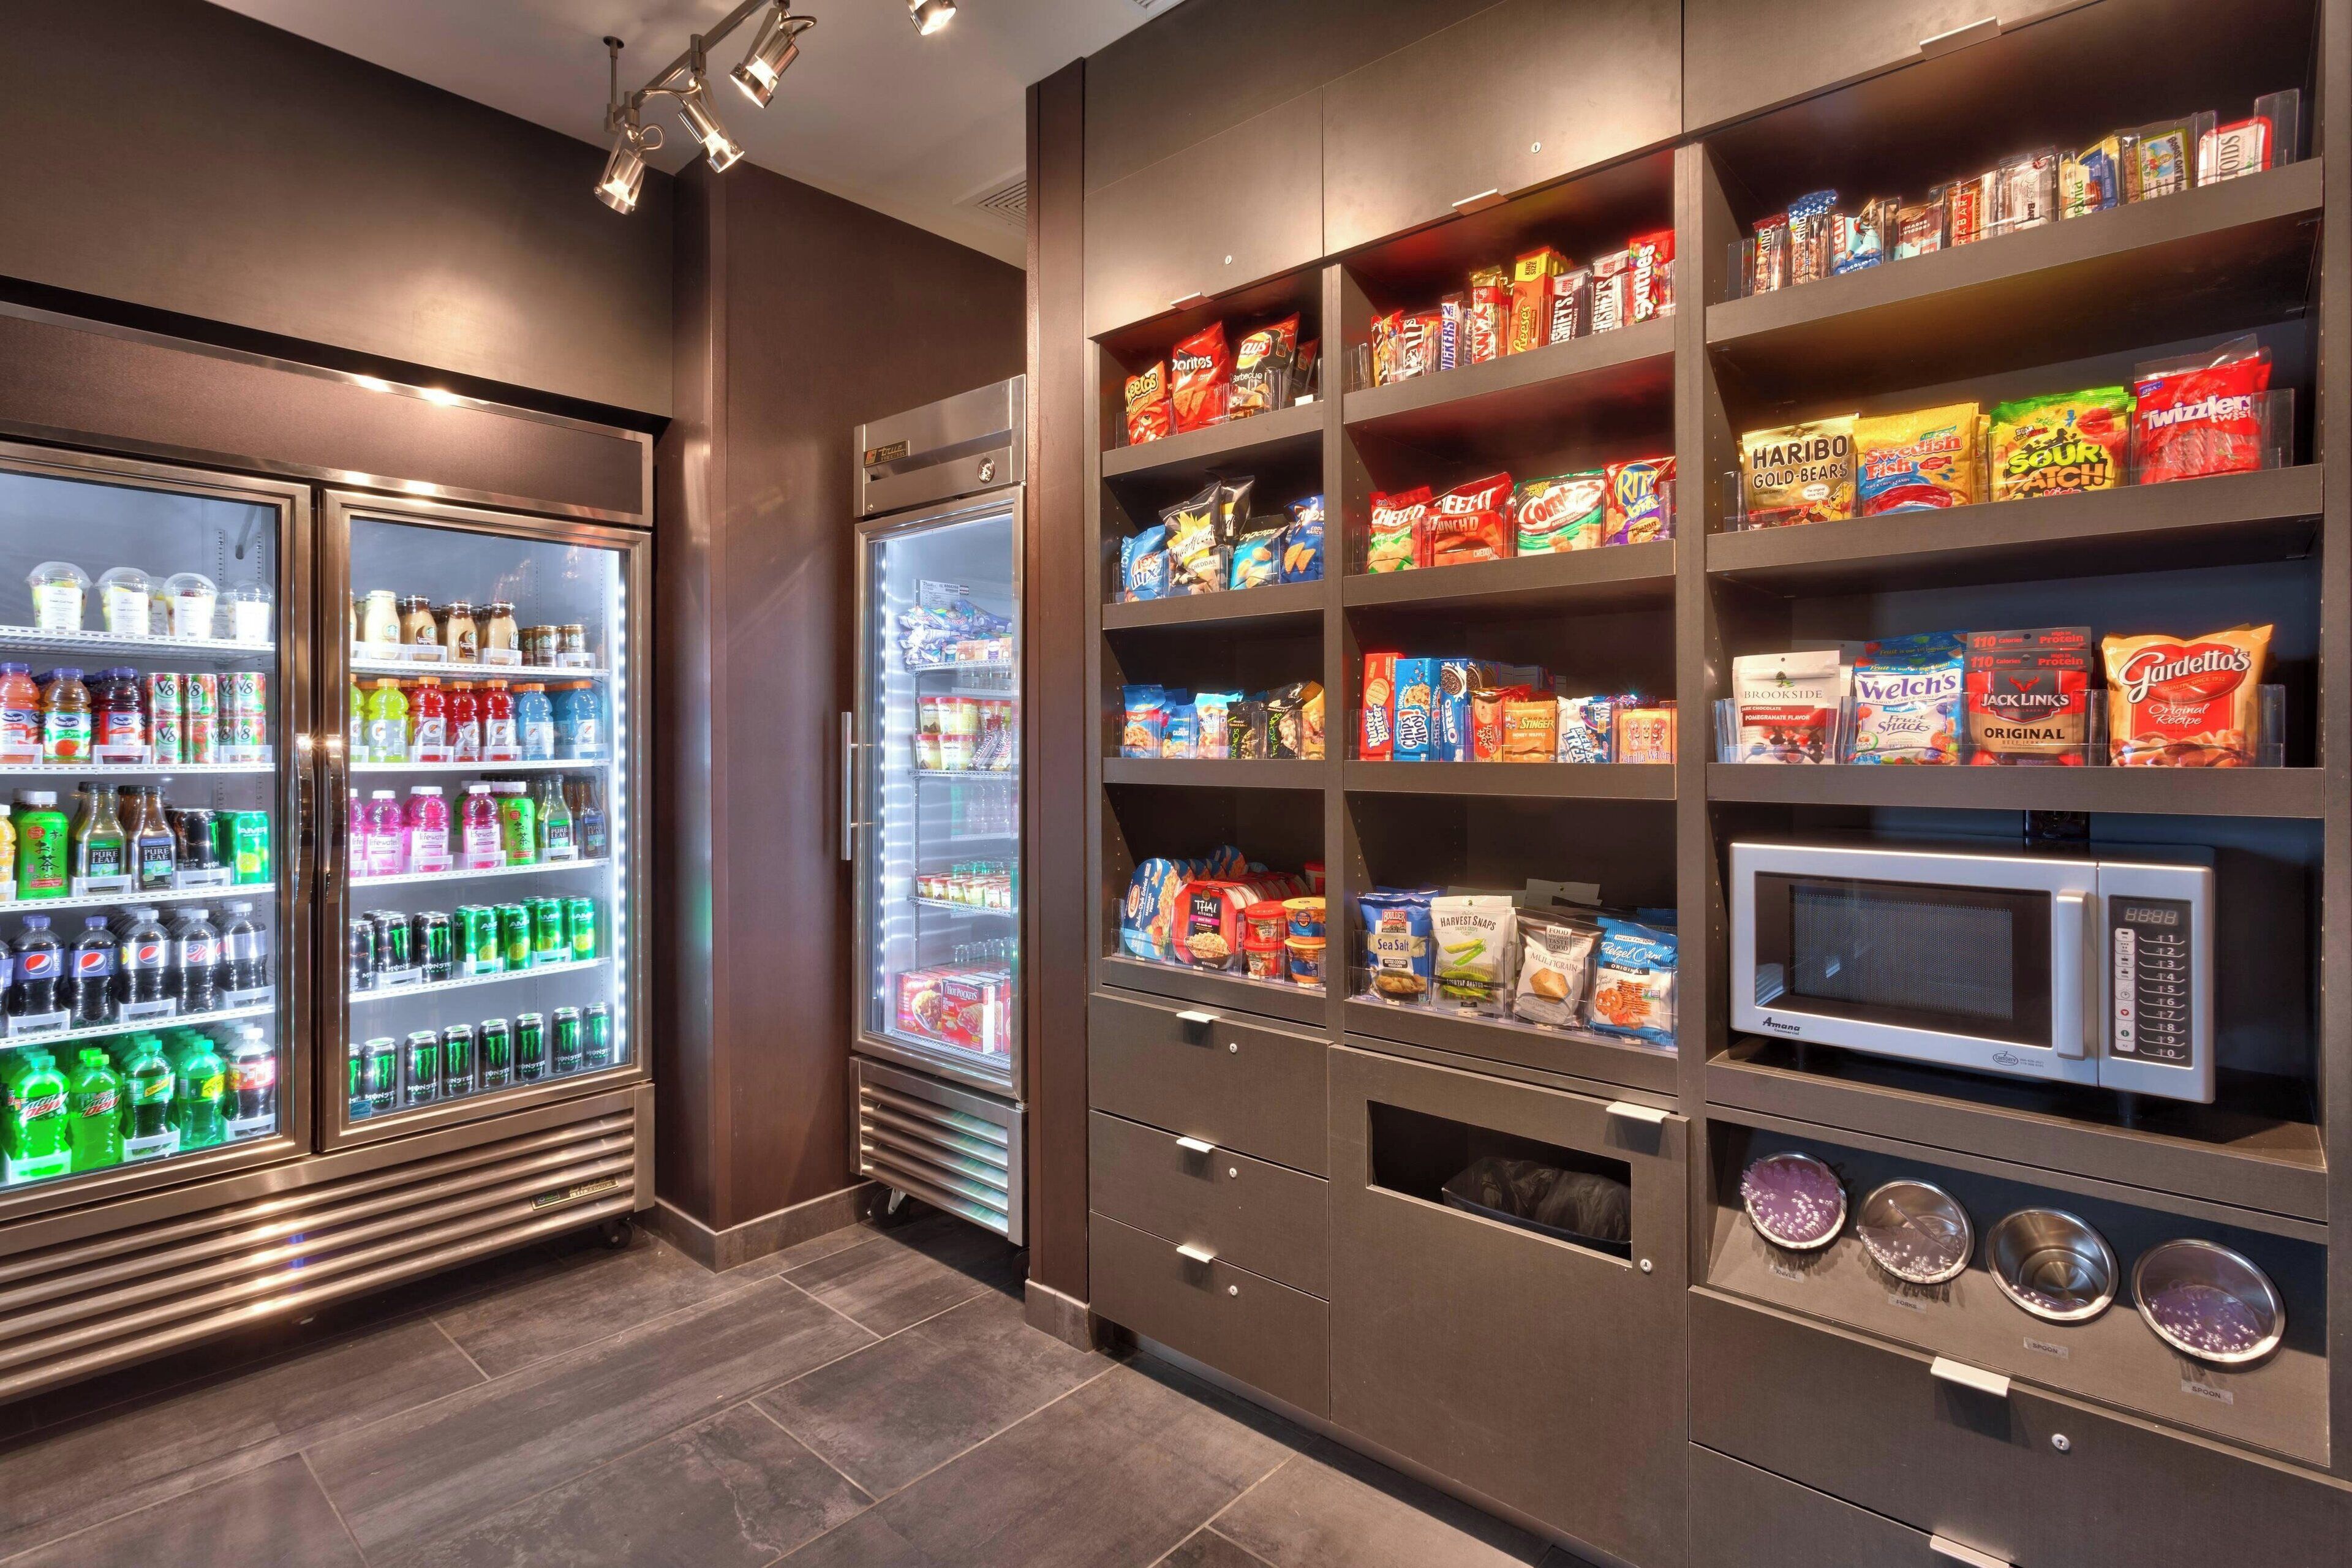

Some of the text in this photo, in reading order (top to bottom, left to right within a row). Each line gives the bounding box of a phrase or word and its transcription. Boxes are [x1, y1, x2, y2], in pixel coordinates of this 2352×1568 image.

[1796, 217, 1806, 244] KIND
[1761, 228, 1772, 254] KIND
[1513, 306, 1531, 352] Reese's
[1753, 435, 1847, 470] HARIBO
[1865, 435, 1962, 464] Swedish
[2009, 442, 2100, 474] SOUR
[1753, 463, 1849, 489] GOLD-BEARS
[1866, 458, 1912, 480] Fish
[2007, 463, 2105, 492] PATCH
[1618, 470, 1658, 504] RITZ
[1191, 559, 1216, 570] CHEDDAR
[1973, 635, 1997, 648] 110
[2038, 634, 2084, 644] Protein
[1970, 656, 1994, 668] 110
[2038, 657, 2084, 666] Protein
[2117, 648, 2252, 704] Gardetto's
[156, 680, 175, 696] V8
[238, 680, 254, 695] V8
[1859, 674, 1956, 700] Welch's
[1744, 690, 1823, 699] BROOKSIDE
[1981, 693, 2070, 707] JACK LINK'S
[2148, 703, 2210, 717] Original
[1372, 704, 1390, 743] Butter
[1444, 699, 1458, 745] OREO
[1519, 718, 1555, 731] STINGER
[1876, 721, 1931, 735] Snacks
[2152, 714, 2203, 728] Recipe
[157, 726, 176, 742] V8
[1365, 709, 1380, 748] Nutter
[1984, 728, 2065, 739] ORIGINAL
[1194, 900, 1217, 913] THAI
[1383, 910, 1406, 922] BOULDER
[1440, 915, 1496, 931] HARVEST SNAPS
[1549, 927, 1569, 936] FOOD
[1378, 939, 1409, 951] Sea Salt
[1600, 941, 1632, 962] Pretzel
[1530, 952, 1578, 972] MULTIGRAIN
[1611, 963, 1643, 974] ORIGINAL
[946, 985, 978, 1001] HOT POCKETS
[1762, 1017, 1801, 1031] Amana
[2167, 1036, 2174, 1044] 9
[2167, 1049, 2174, 1058] 0
[1776, 1270, 1796, 1280] KNIVES
[1896, 1299, 1918, 1310] FORKS
[2032, 1343, 2059, 1354] SPOON
[2191, 1386, 2222, 1399] SPOON
